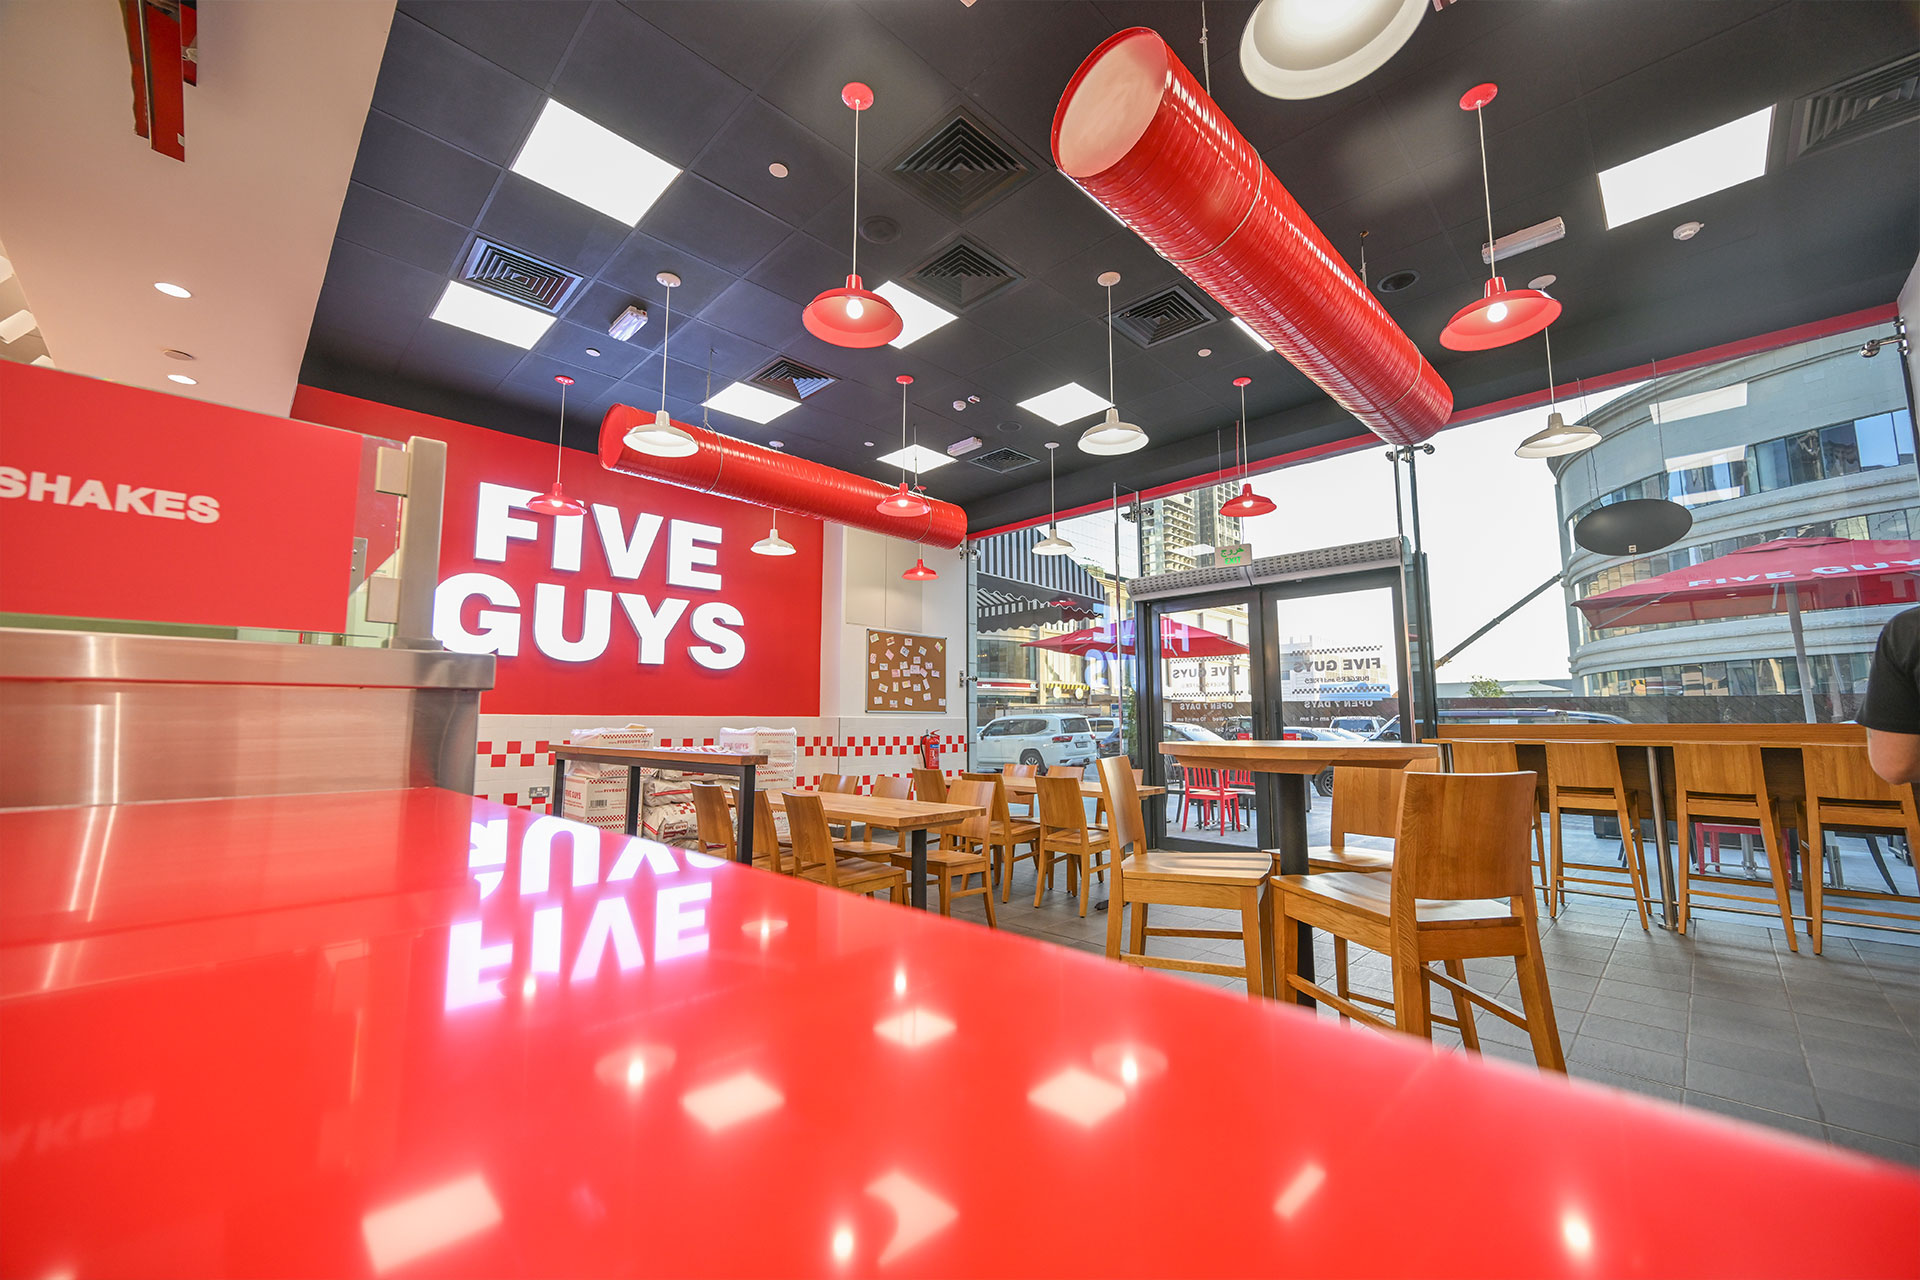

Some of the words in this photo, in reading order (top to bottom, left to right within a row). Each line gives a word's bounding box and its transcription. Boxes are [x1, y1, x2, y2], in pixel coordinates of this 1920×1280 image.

[0, 466, 220, 524] SHAKES
[473, 481, 723, 591] FIVE
[1225, 556, 1240, 565] EXIT
[1689, 570, 1795, 587] FIVE
[432, 573, 746, 670] GUYS
